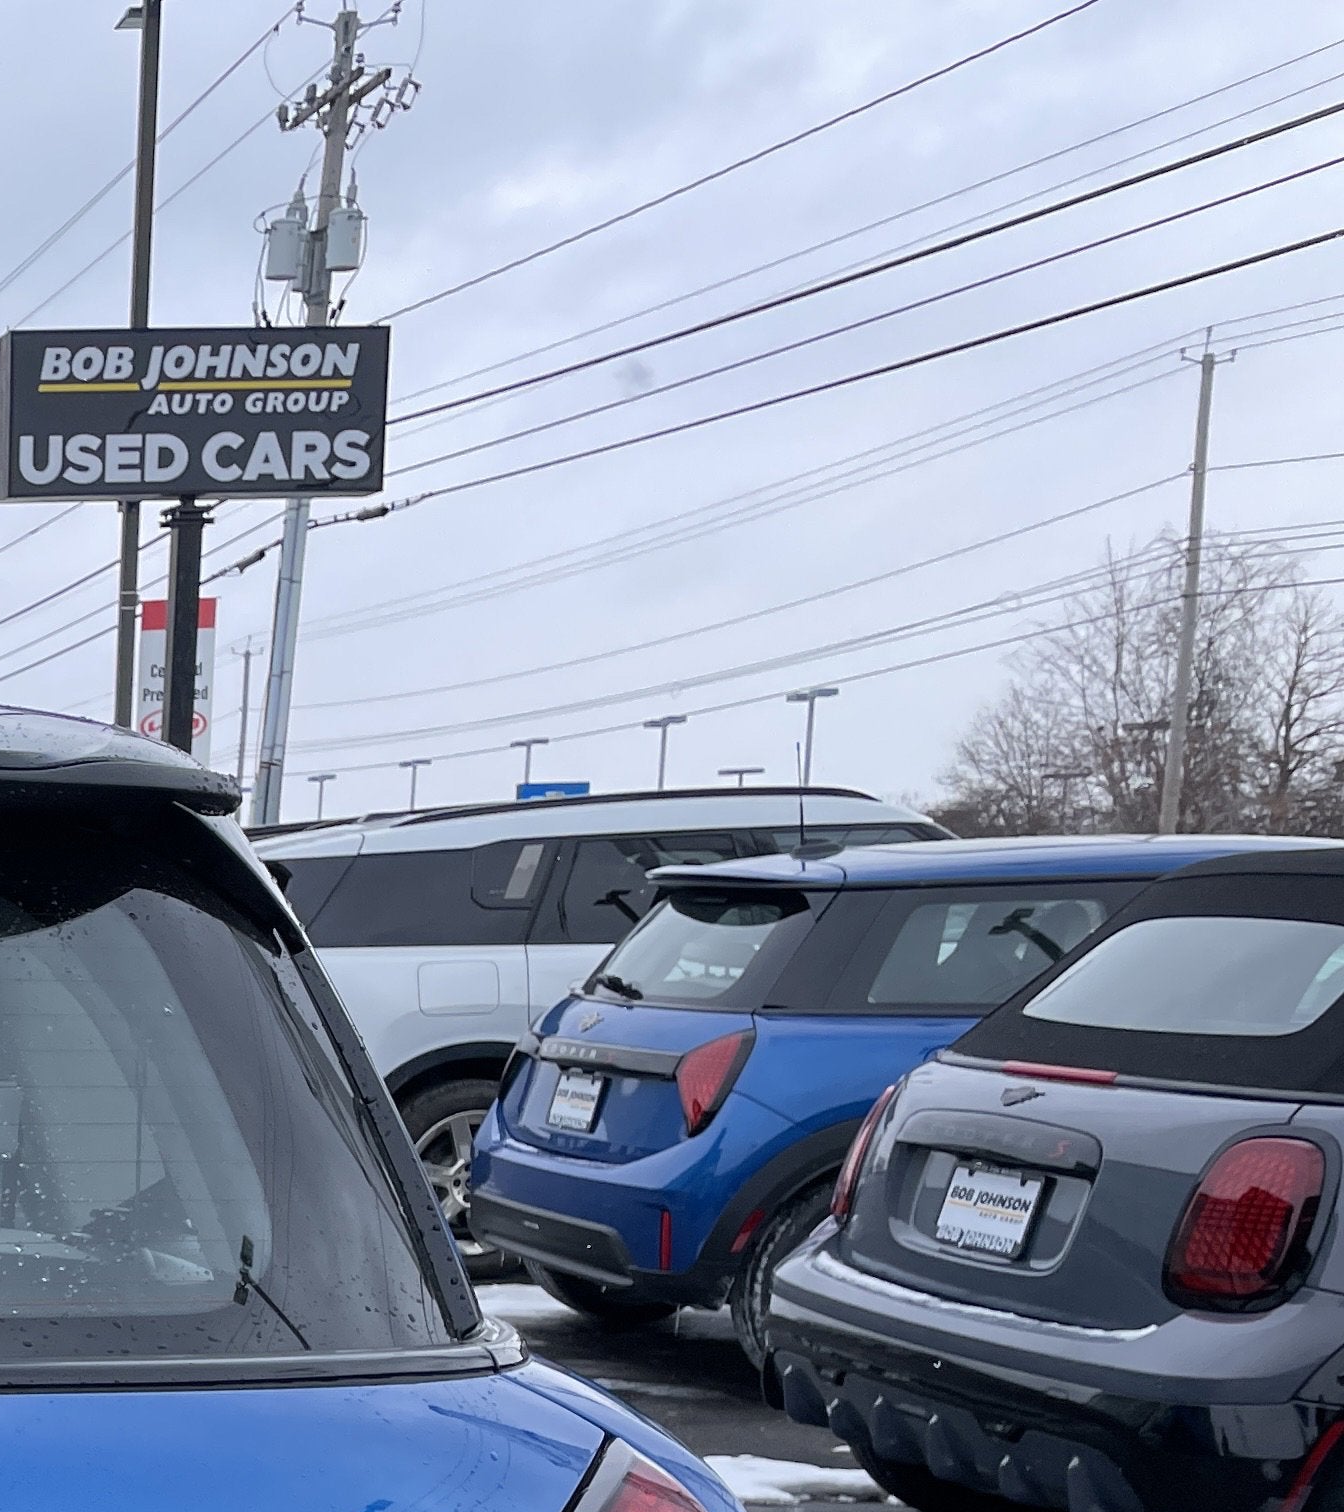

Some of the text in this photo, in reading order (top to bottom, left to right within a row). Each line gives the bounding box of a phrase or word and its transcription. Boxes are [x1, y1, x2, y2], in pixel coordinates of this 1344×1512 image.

[40, 342, 360, 390] BOB JOHNSON
[147, 390, 350, 415] AUTO GROUP
[18, 429, 372, 486] USED CARS
[951, 1186, 1032, 1213] BOB JOHNSON
